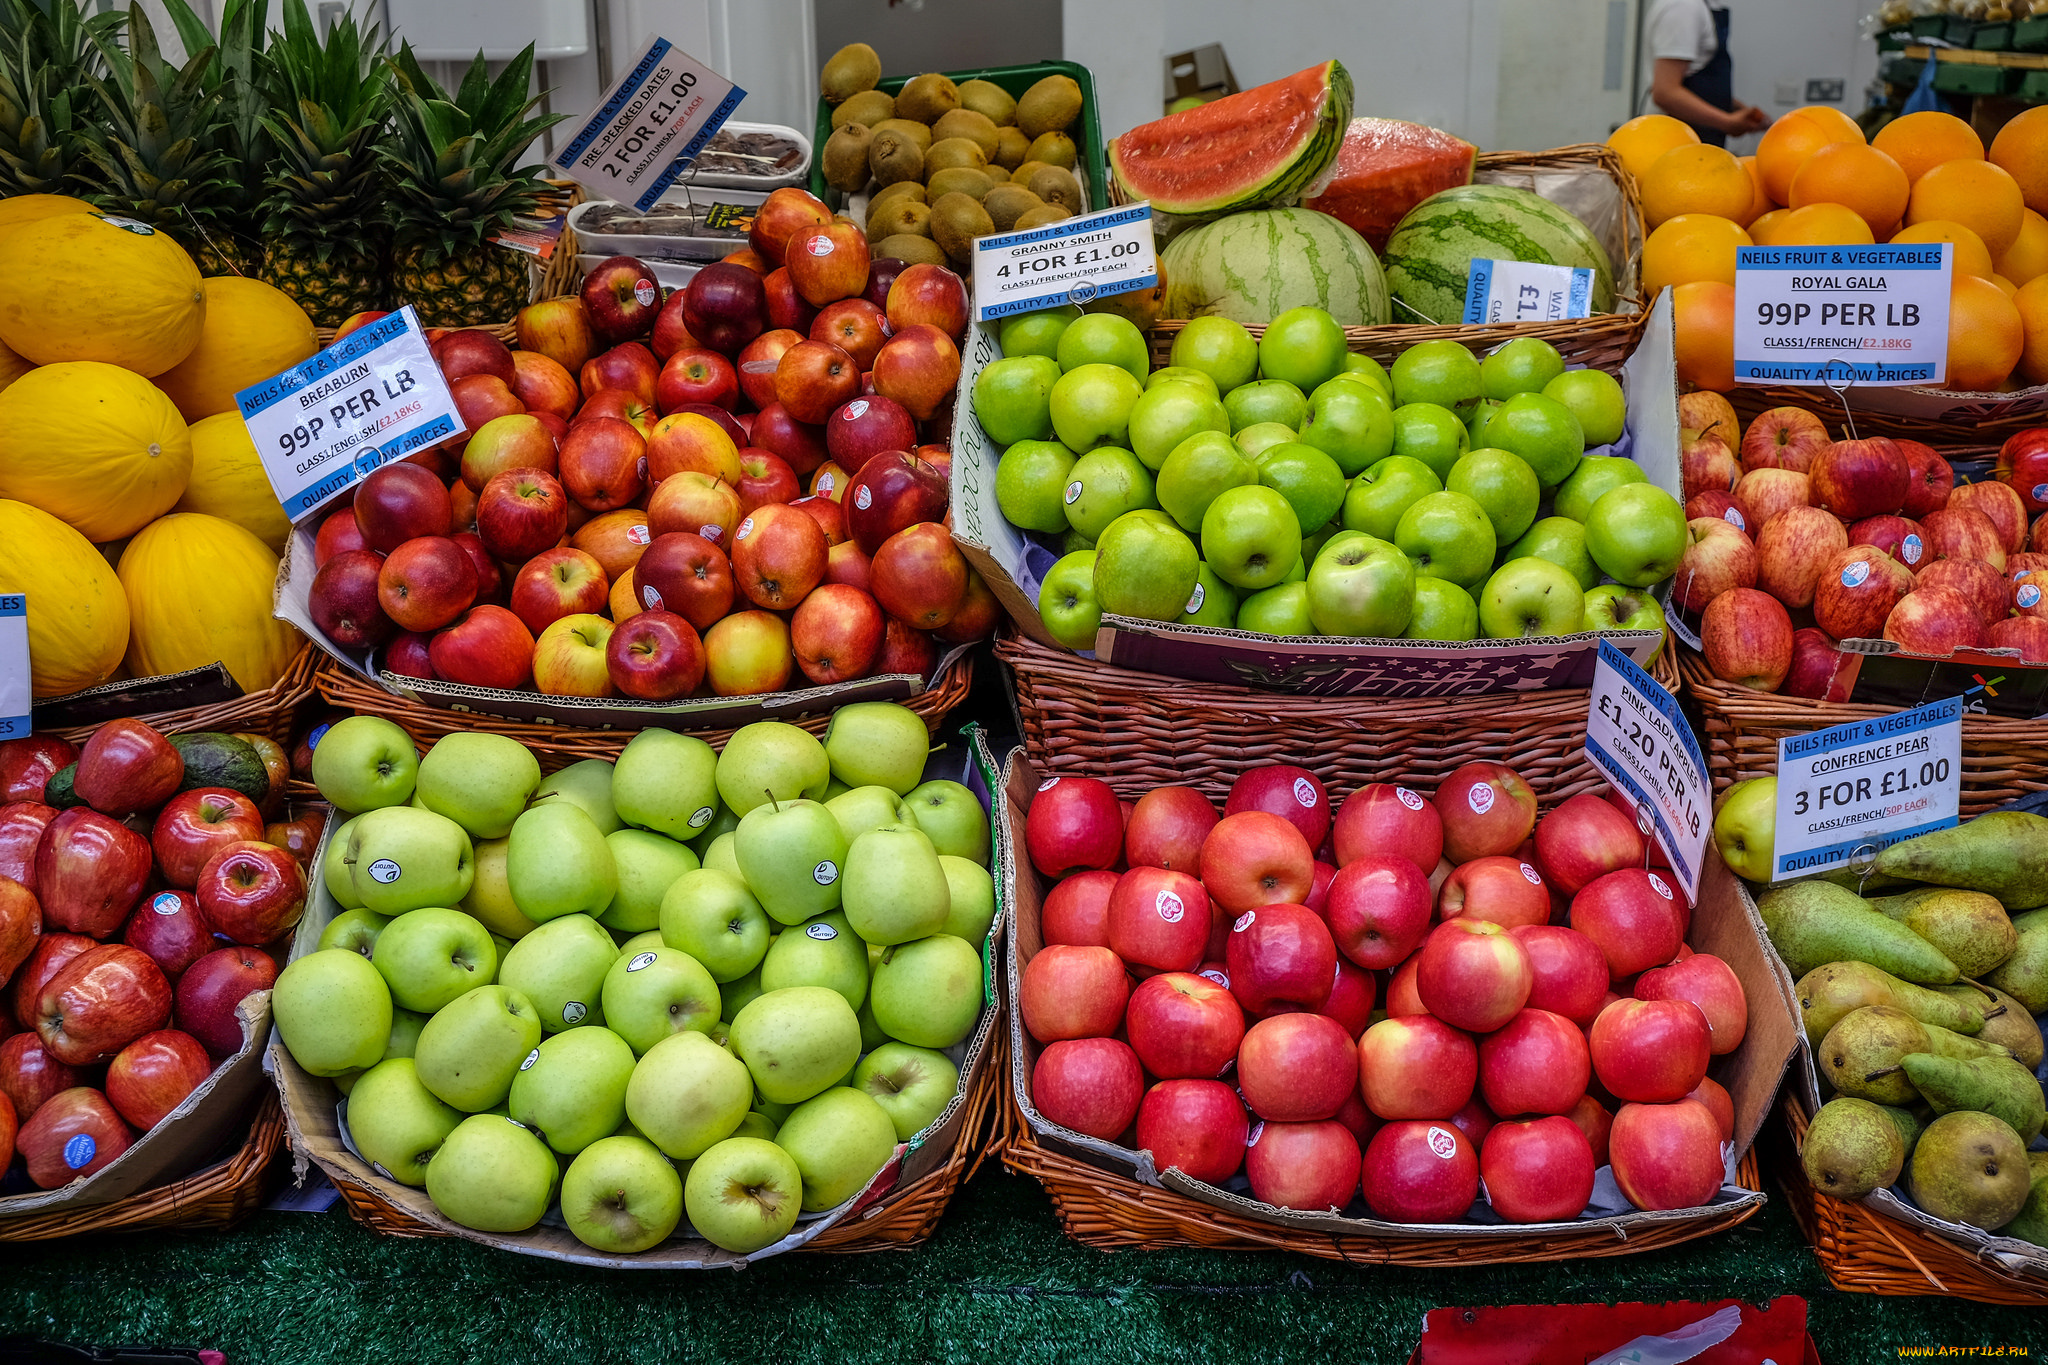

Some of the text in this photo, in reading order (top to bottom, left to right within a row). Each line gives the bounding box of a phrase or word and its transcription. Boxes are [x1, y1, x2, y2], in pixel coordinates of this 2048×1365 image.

[556, 44, 663, 167] NEILS FRUIT & VEGETABLES
[582, 146, 602, 168] PRE
[640, 66, 671, 101] DATES
[602, 71, 698, 178] 2 FOR £1.00
[626, 95, 704, 185] CLASS1/TUNISA/70P EACH
[641, 165, 678, 207] QUALITY
[686, 133, 708, 155] LOW
[706, 96, 736, 132] PRICES
[979, 208, 1145, 248] NEILS FRUIT & VEGETABLES
[1011, 231, 1113, 257] GRANNY SMITH
[997, 241, 1140, 278] 4 FOR £1.00
[1001, 262, 1128, 290] CLASS1/FRENCH/30P EACH
[1742, 251, 1942, 264] NEILS FRUIT & VEGETABLES
[1792, 276, 1887, 289] ROYAL GALA
[987, 298, 1042, 316] QUALITY
[1046, 294, 1064, 306] AT
[1100, 279, 1144, 294] PRICES
[1470, 272, 1486, 325] QUALITY
[1757, 303, 1921, 327] 99P PER LB
[244, 387, 278, 412] NEILS
[317, 359, 329, 371] &
[329, 315, 407, 363] VEGETABLES
[1763, 337, 1912, 349] CLASS1/FRENCH/£2.18KG
[300, 362, 370, 408] BREABURN
[1750, 367, 1927, 381] QUALITY AT LOW PRICES
[279, 369, 416, 457] 99P PER LB
[296, 400, 422, 475] CLASS1/ENGLISH/£2.18KG
[302, 472, 350, 509] QUALITY
[371, 445, 400, 468] LOW
[404, 422, 449, 451] PRICES
[1604, 646, 1634, 678] NEILS
[1635, 672, 1666, 706] FRUIT
[1621, 685, 1699, 789] PINK LADY APPLES
[1784, 737, 1819, 754] NEILS
[1822, 727, 1861, 747] FRUIT
[1864, 723, 1874, 737] &
[1878, 704, 1956, 734] VEGETABLES
[1598, 694, 1701, 839] £1.20 PER LB
[1811, 736, 1929, 774] CONFRENCE PEAR
[1794, 758, 1950, 815] 3 FOR £1.00
[1595, 750, 1636, 796] QUALITY
[1667, 839, 1690, 878] PRICES
[1808, 797, 1928, 832] CLASS1/FRENCH/50P EACH
[1786, 849, 1845, 872] QUALITY
